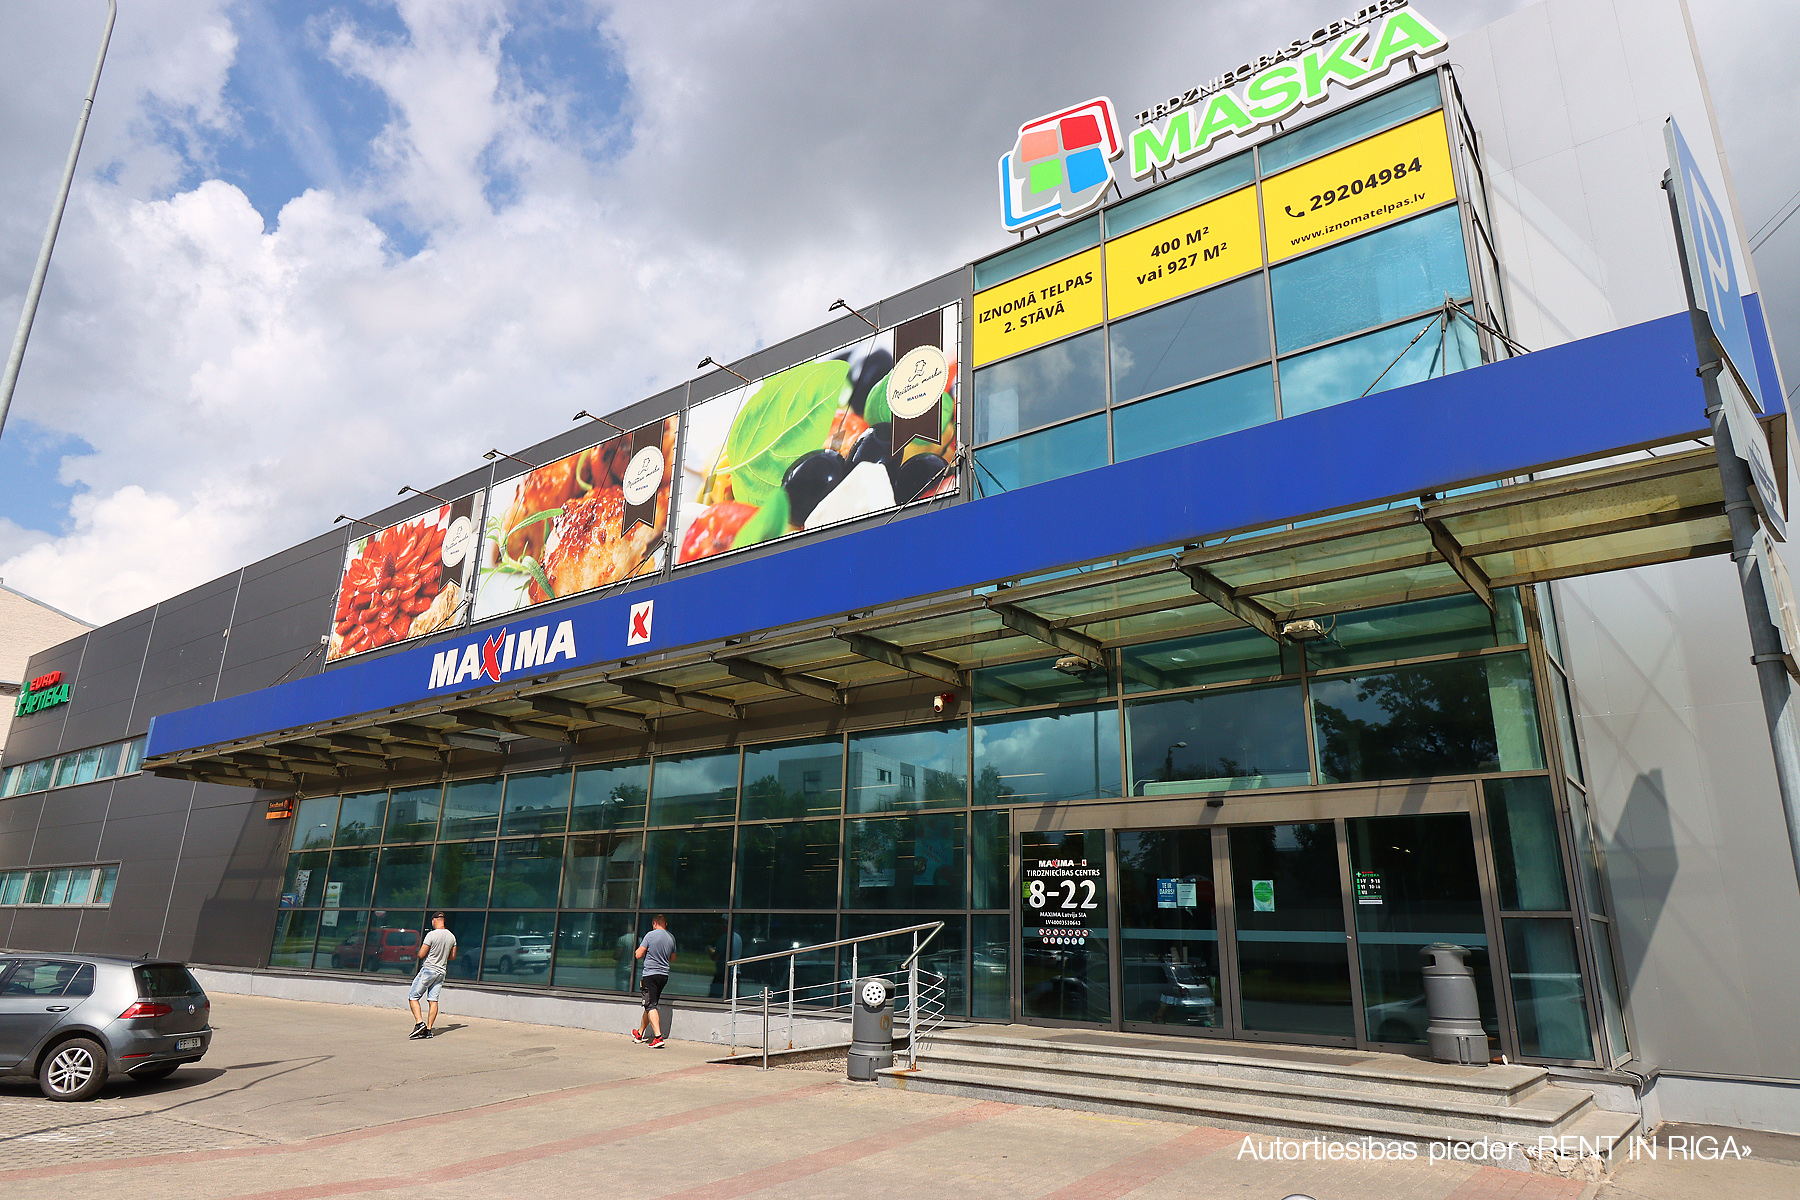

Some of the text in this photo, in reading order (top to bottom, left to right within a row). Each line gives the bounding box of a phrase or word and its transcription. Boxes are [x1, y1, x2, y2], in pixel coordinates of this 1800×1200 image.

[1131, 8, 1446, 178] MASKA
[1310, 157, 1422, 212] 29204984
[1291, 192, 1426, 246] www.iznomatelpas.lv
[1151, 238, 1181, 258] 400
[1137, 265, 1163, 286] vai
[1168, 253, 1198, 275] 927
[979, 271, 1093, 325] IZNOMĀ TELPAS
[1004, 300, 1065, 334] 2. STĀVĀ
[427, 619, 577, 690] MAXIMA
[29, 670, 61, 692] EURO
[23, 684, 70, 714] APTIEKA
[1038, 859, 1074, 868] MAXIMA
